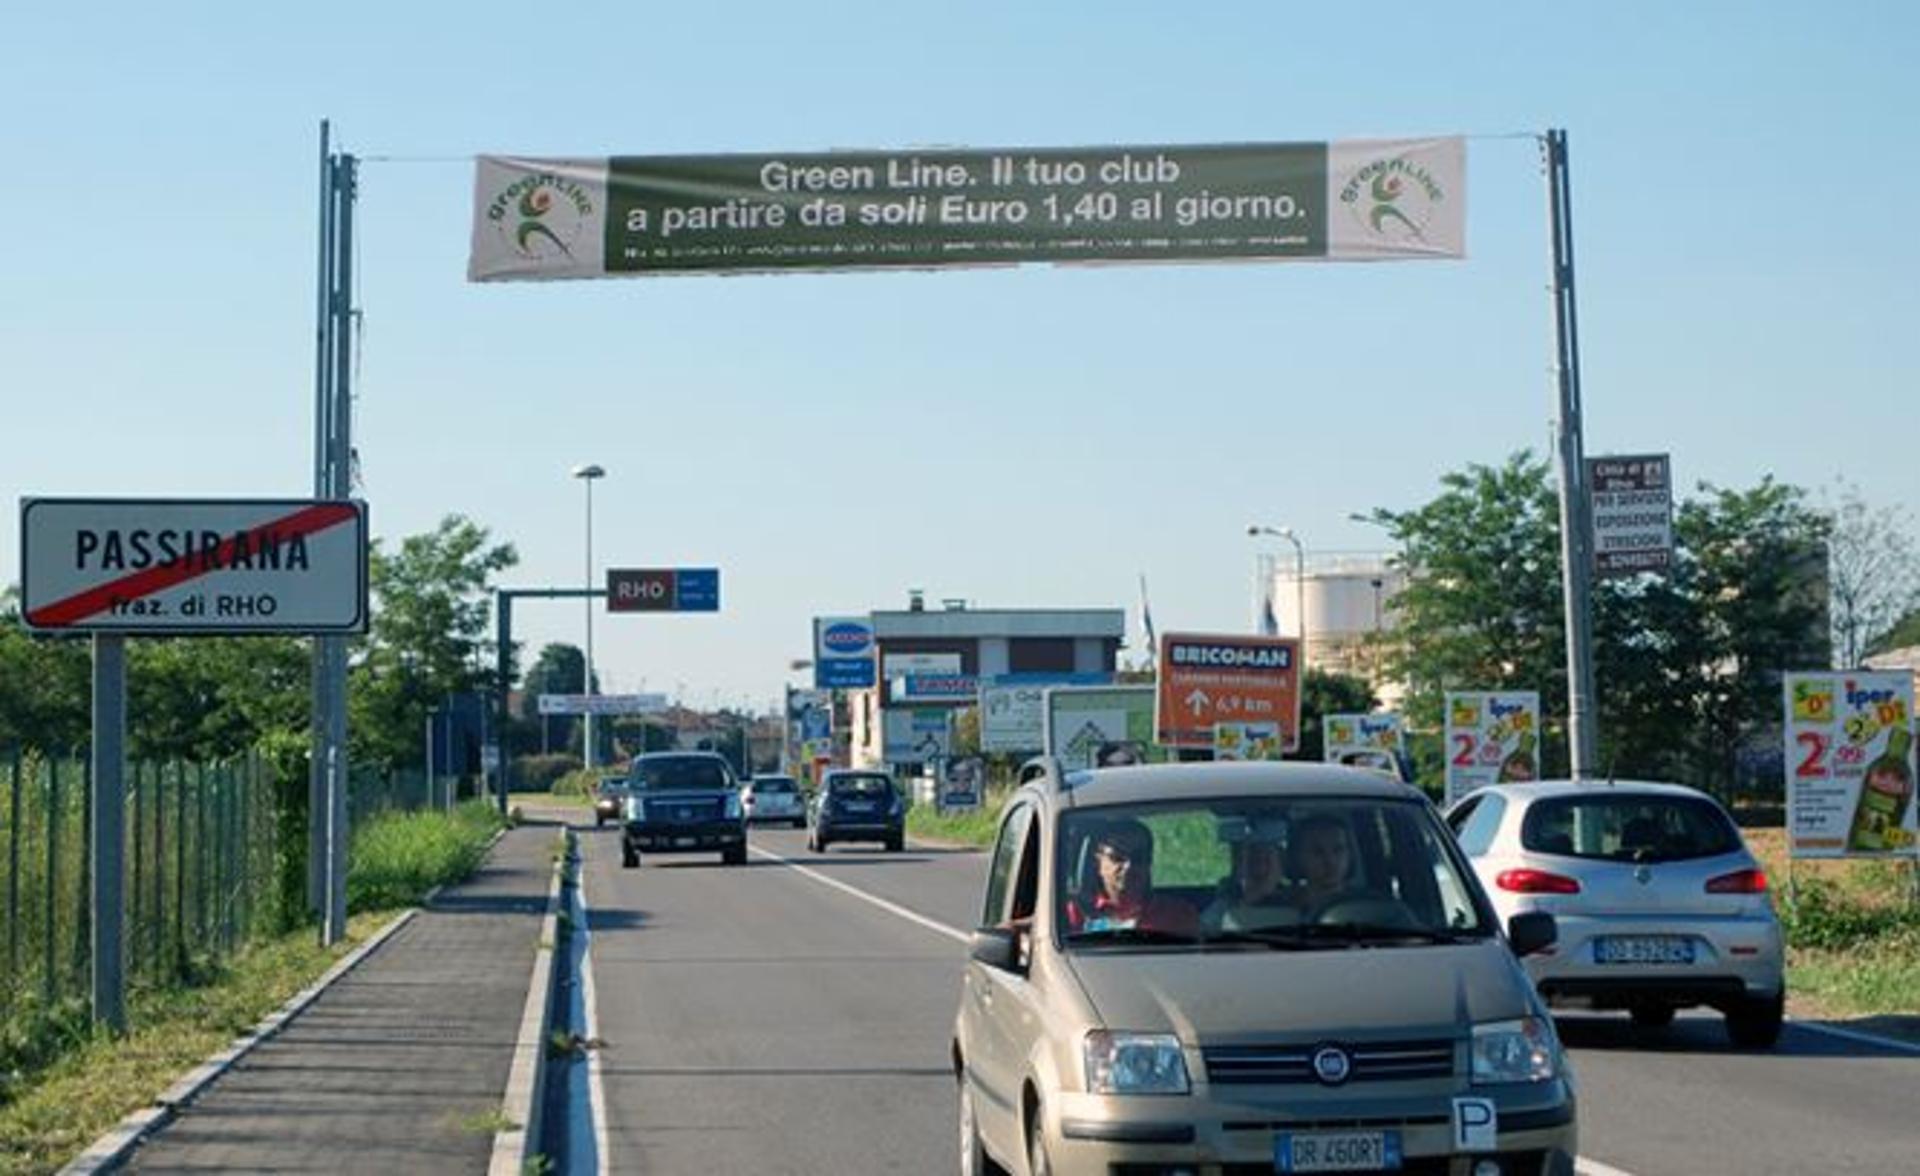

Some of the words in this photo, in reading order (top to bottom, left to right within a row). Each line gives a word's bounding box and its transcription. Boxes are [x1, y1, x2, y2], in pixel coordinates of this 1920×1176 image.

[759, 160, 875, 192] Green
[887, 156, 977, 188] Line.
[991, 157, 1013, 185] Il
[1023, 157, 1086, 185] tuo
[1100, 154, 1180, 184] club
[626, 207, 648, 232] a
[661, 197, 786, 237] partire
[800, 198, 847, 227] da
[858, 195, 927, 225] soli
[940, 194, 1028, 224] Euro
[1042, 192, 1118, 227] 1,40
[1130, 192, 1163, 221] al
[1175, 190, 1306, 226] giorno.
[75, 529, 310, 571] PASSIRANA
[179, 593, 205, 617] di
[216, 595, 278, 617] RHO
[617, 580, 665, 599] RHO
[1172, 645, 1288, 668] BRICOMAN
[1245, 696, 1273, 712] km
[1458, 1101, 1492, 1144] P
